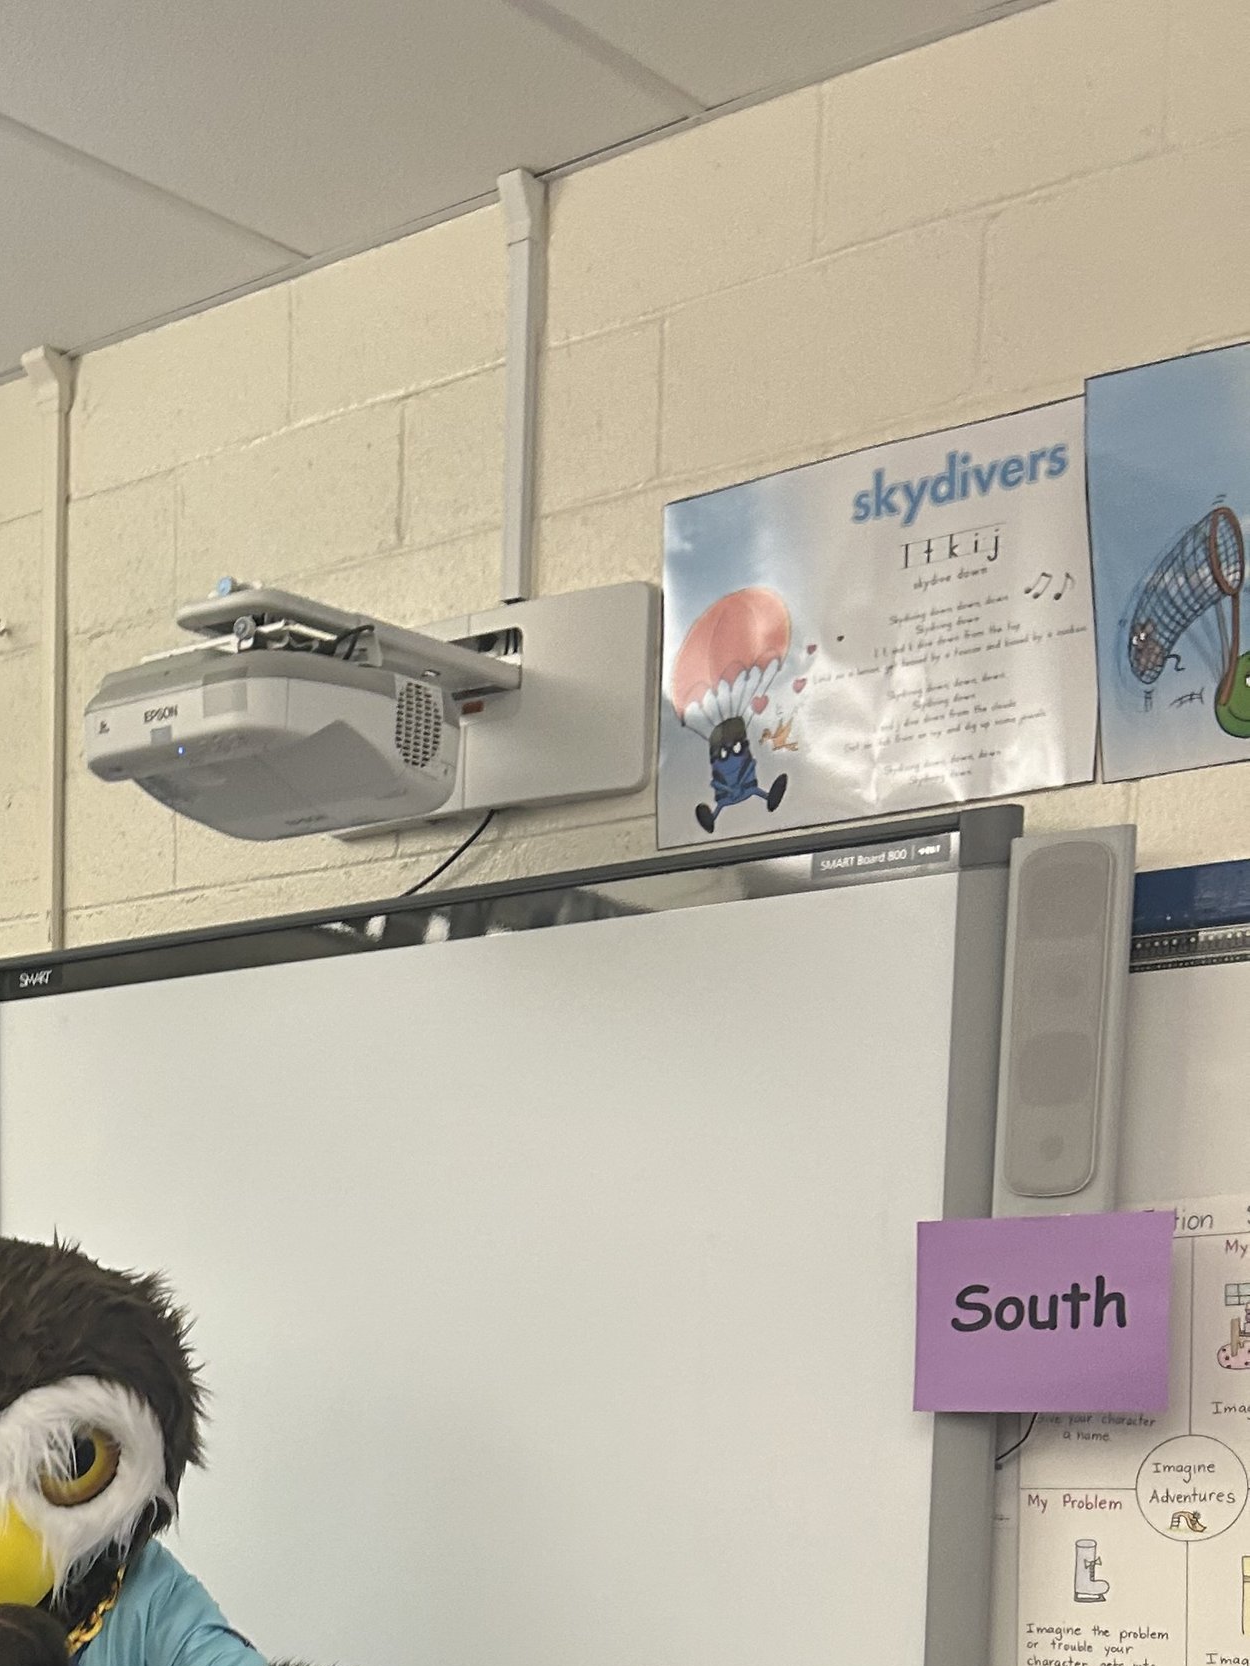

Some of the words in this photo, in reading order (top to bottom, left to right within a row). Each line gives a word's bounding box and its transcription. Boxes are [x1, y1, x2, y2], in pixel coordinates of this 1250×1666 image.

[853, 444, 1069, 526] skydivers
[948, 534, 959, 559] k
[987, 528, 1000, 561] j
[957, 567, 988, 580] down
[143, 704, 178, 724] EPSON
[820, 856, 855, 871] SMART
[857, 851, 885, 866] Board
[887, 849, 907, 861] 800
[1225, 1239, 1248, 1258] My
[951, 1275, 1127, 1332] South
[1068, 1414, 1092, 1427] your
[1101, 1413, 1156, 1427] character
[1063, 1431, 1071, 1440] a
[1152, 1462, 1216, 1483] Imagine
[1028, 1494, 1048, 1513] My
[1063, 1494, 1123, 1511] Problem
[1149, 1489, 1236, 1504] Adventures
[1026, 1623, 1082, 1641] Imagine
[1092, 1624, 1110, 1637] the
[1119, 1628, 1169, 1641] problem
[1026, 1640, 1038, 1649] or
[1050, 1640, 1093, 1653] trouble
[1103, 1645, 1133, 1656] your
